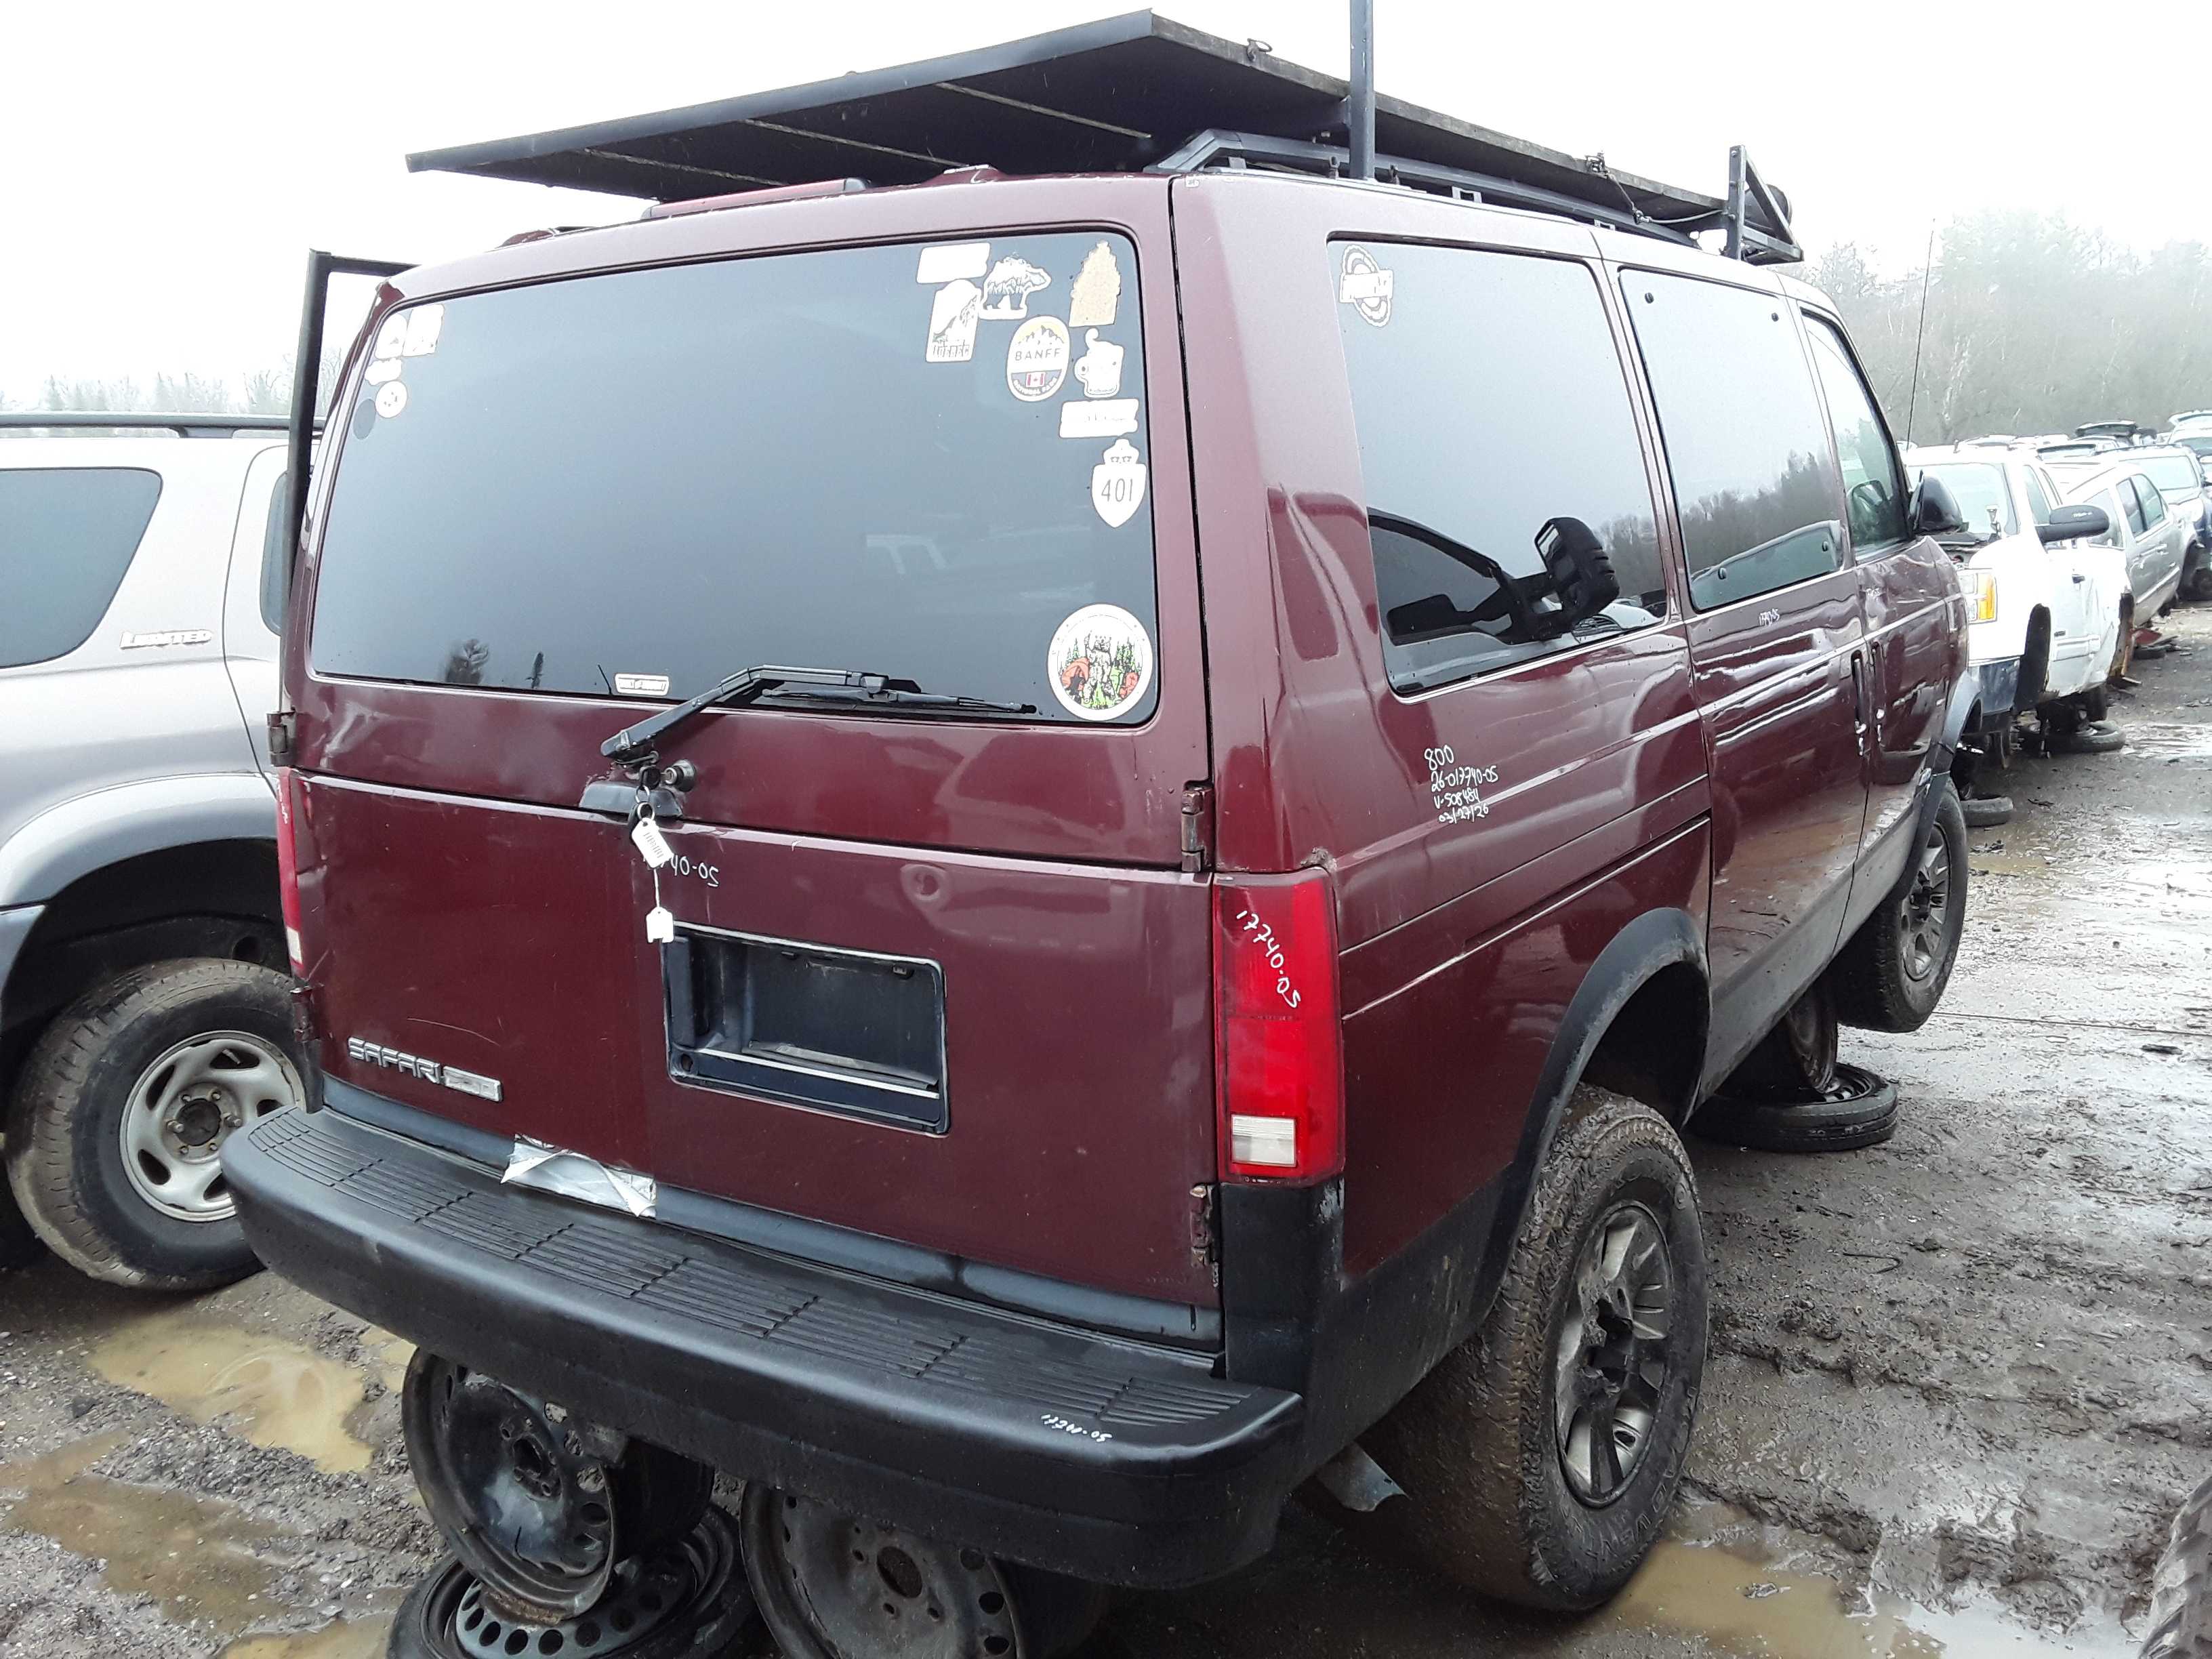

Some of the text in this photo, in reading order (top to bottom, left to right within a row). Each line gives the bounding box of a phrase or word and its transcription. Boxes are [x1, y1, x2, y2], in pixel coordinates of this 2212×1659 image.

[1015, 347, 1063, 362] BANFF
[1100, 478, 1134, 502] 401
[1424, 744, 1455, 771] 800
[661, 853, 720, 888] 40-05
[348, 1036, 441, 1084] SAFARI
